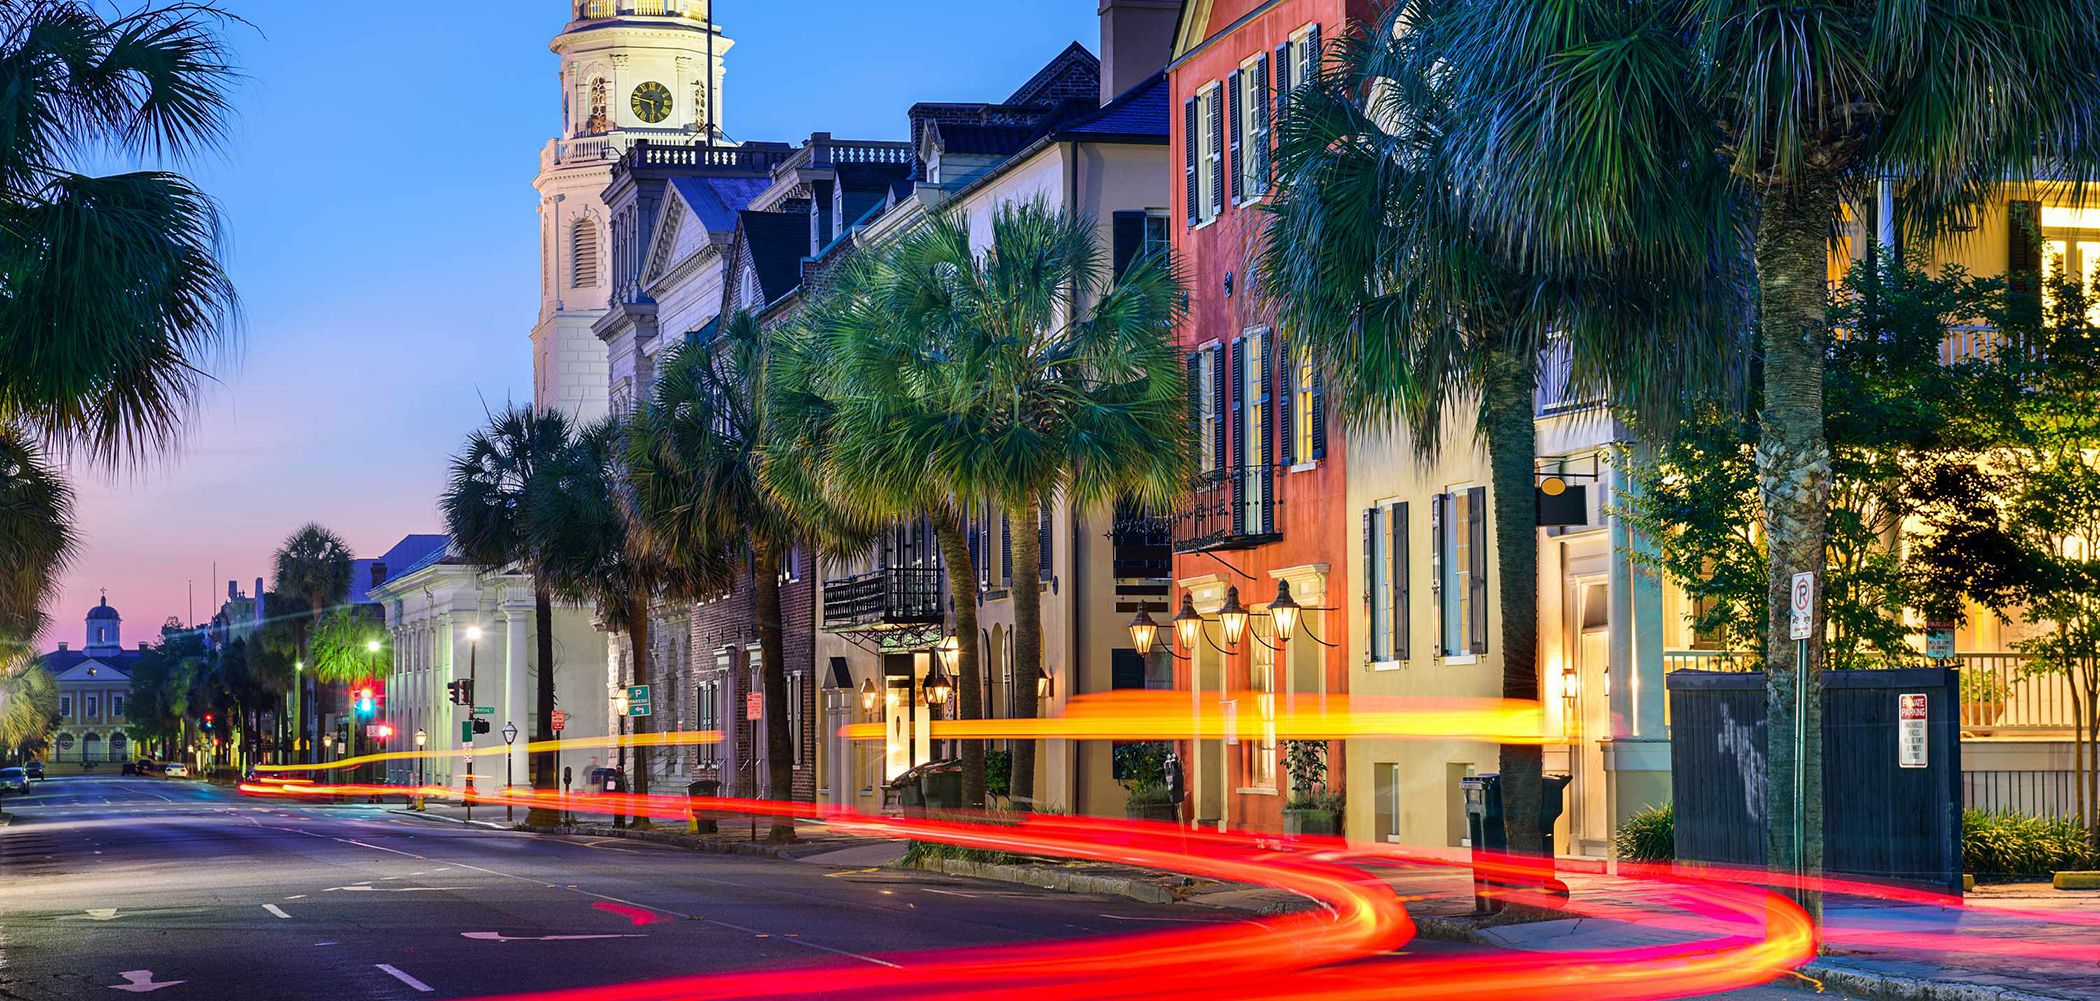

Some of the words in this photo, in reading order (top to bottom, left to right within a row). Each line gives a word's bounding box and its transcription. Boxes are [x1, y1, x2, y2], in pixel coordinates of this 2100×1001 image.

[635, 689, 642, 698] P
[1902, 698, 1925, 707] PVATE
[1901, 707, 1926, 716] PARKING
